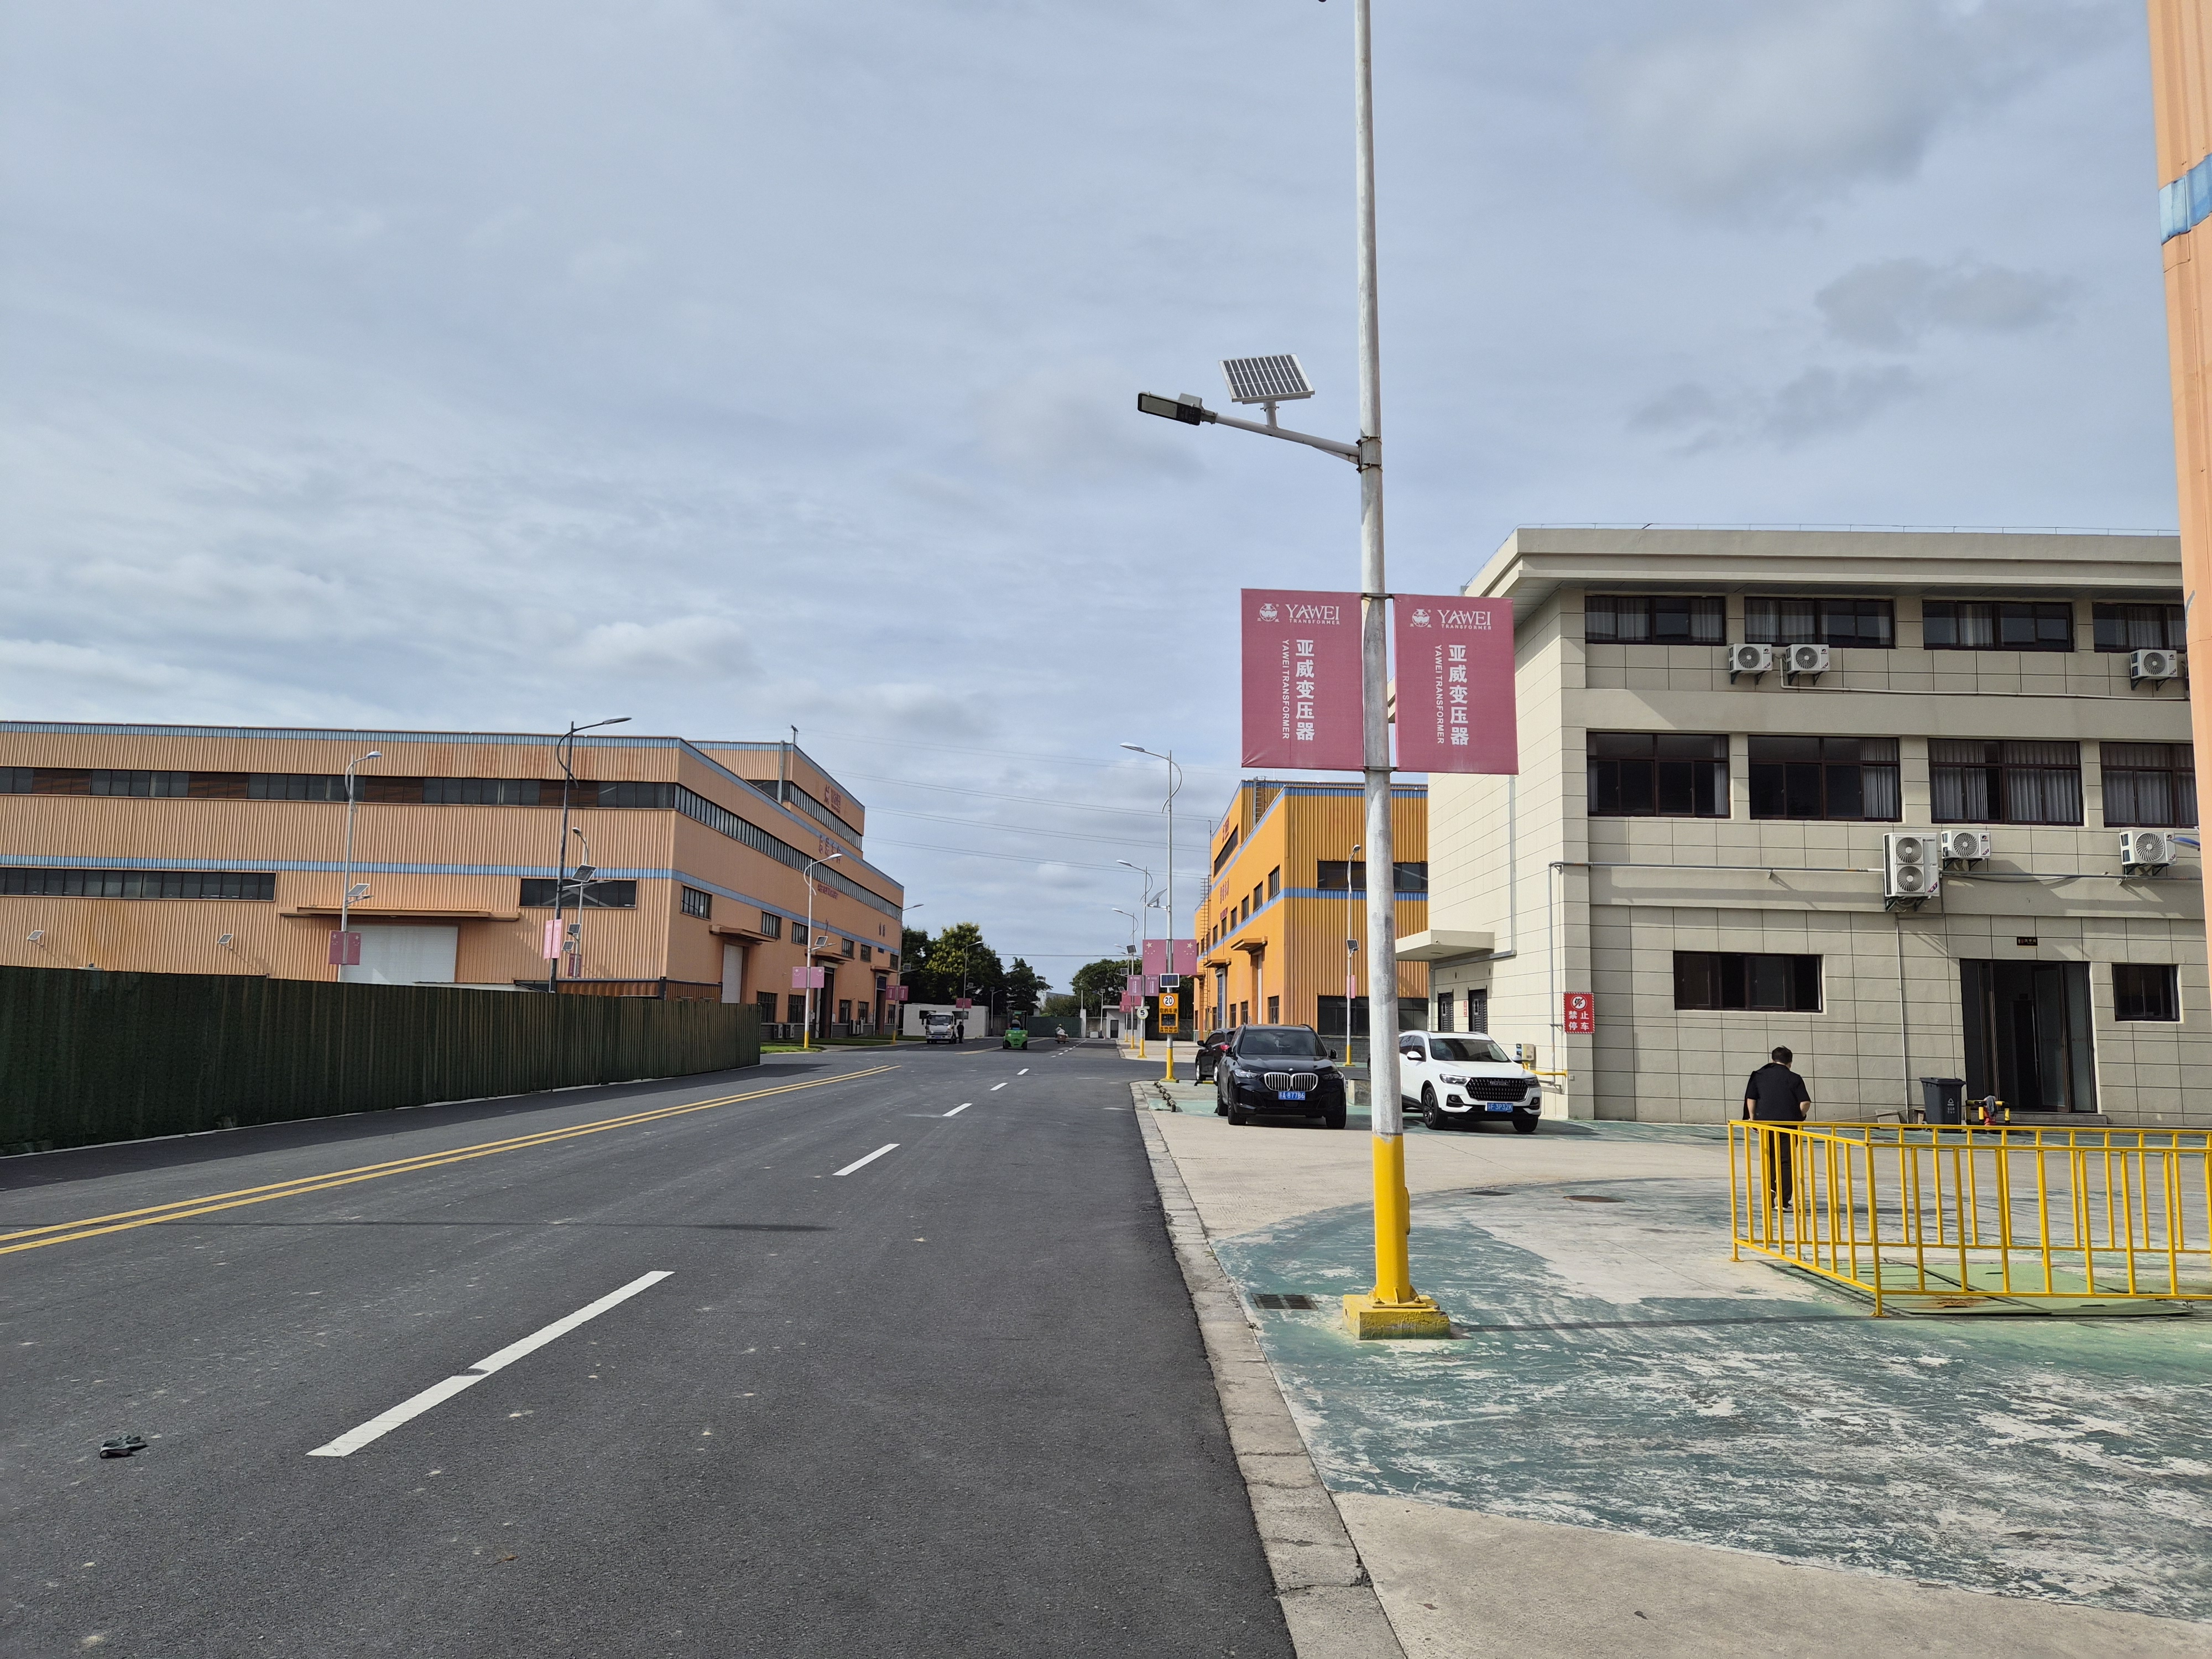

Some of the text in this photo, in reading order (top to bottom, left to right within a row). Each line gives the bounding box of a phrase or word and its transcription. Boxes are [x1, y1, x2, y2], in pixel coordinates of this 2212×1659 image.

[1285, 604, 1340, 620] YAWEI
[1437, 609, 1491, 625] YAWEI
[1295, 639, 1315, 741] 亚威变压器
[1434, 644, 1444, 744] YAWEI TRANSFORMER
[1448, 644, 1469, 745] 亚威变压器
[1568, 1010, 1589, 1020] 禁止
[1568, 1021, 1589, 1031] 停车
